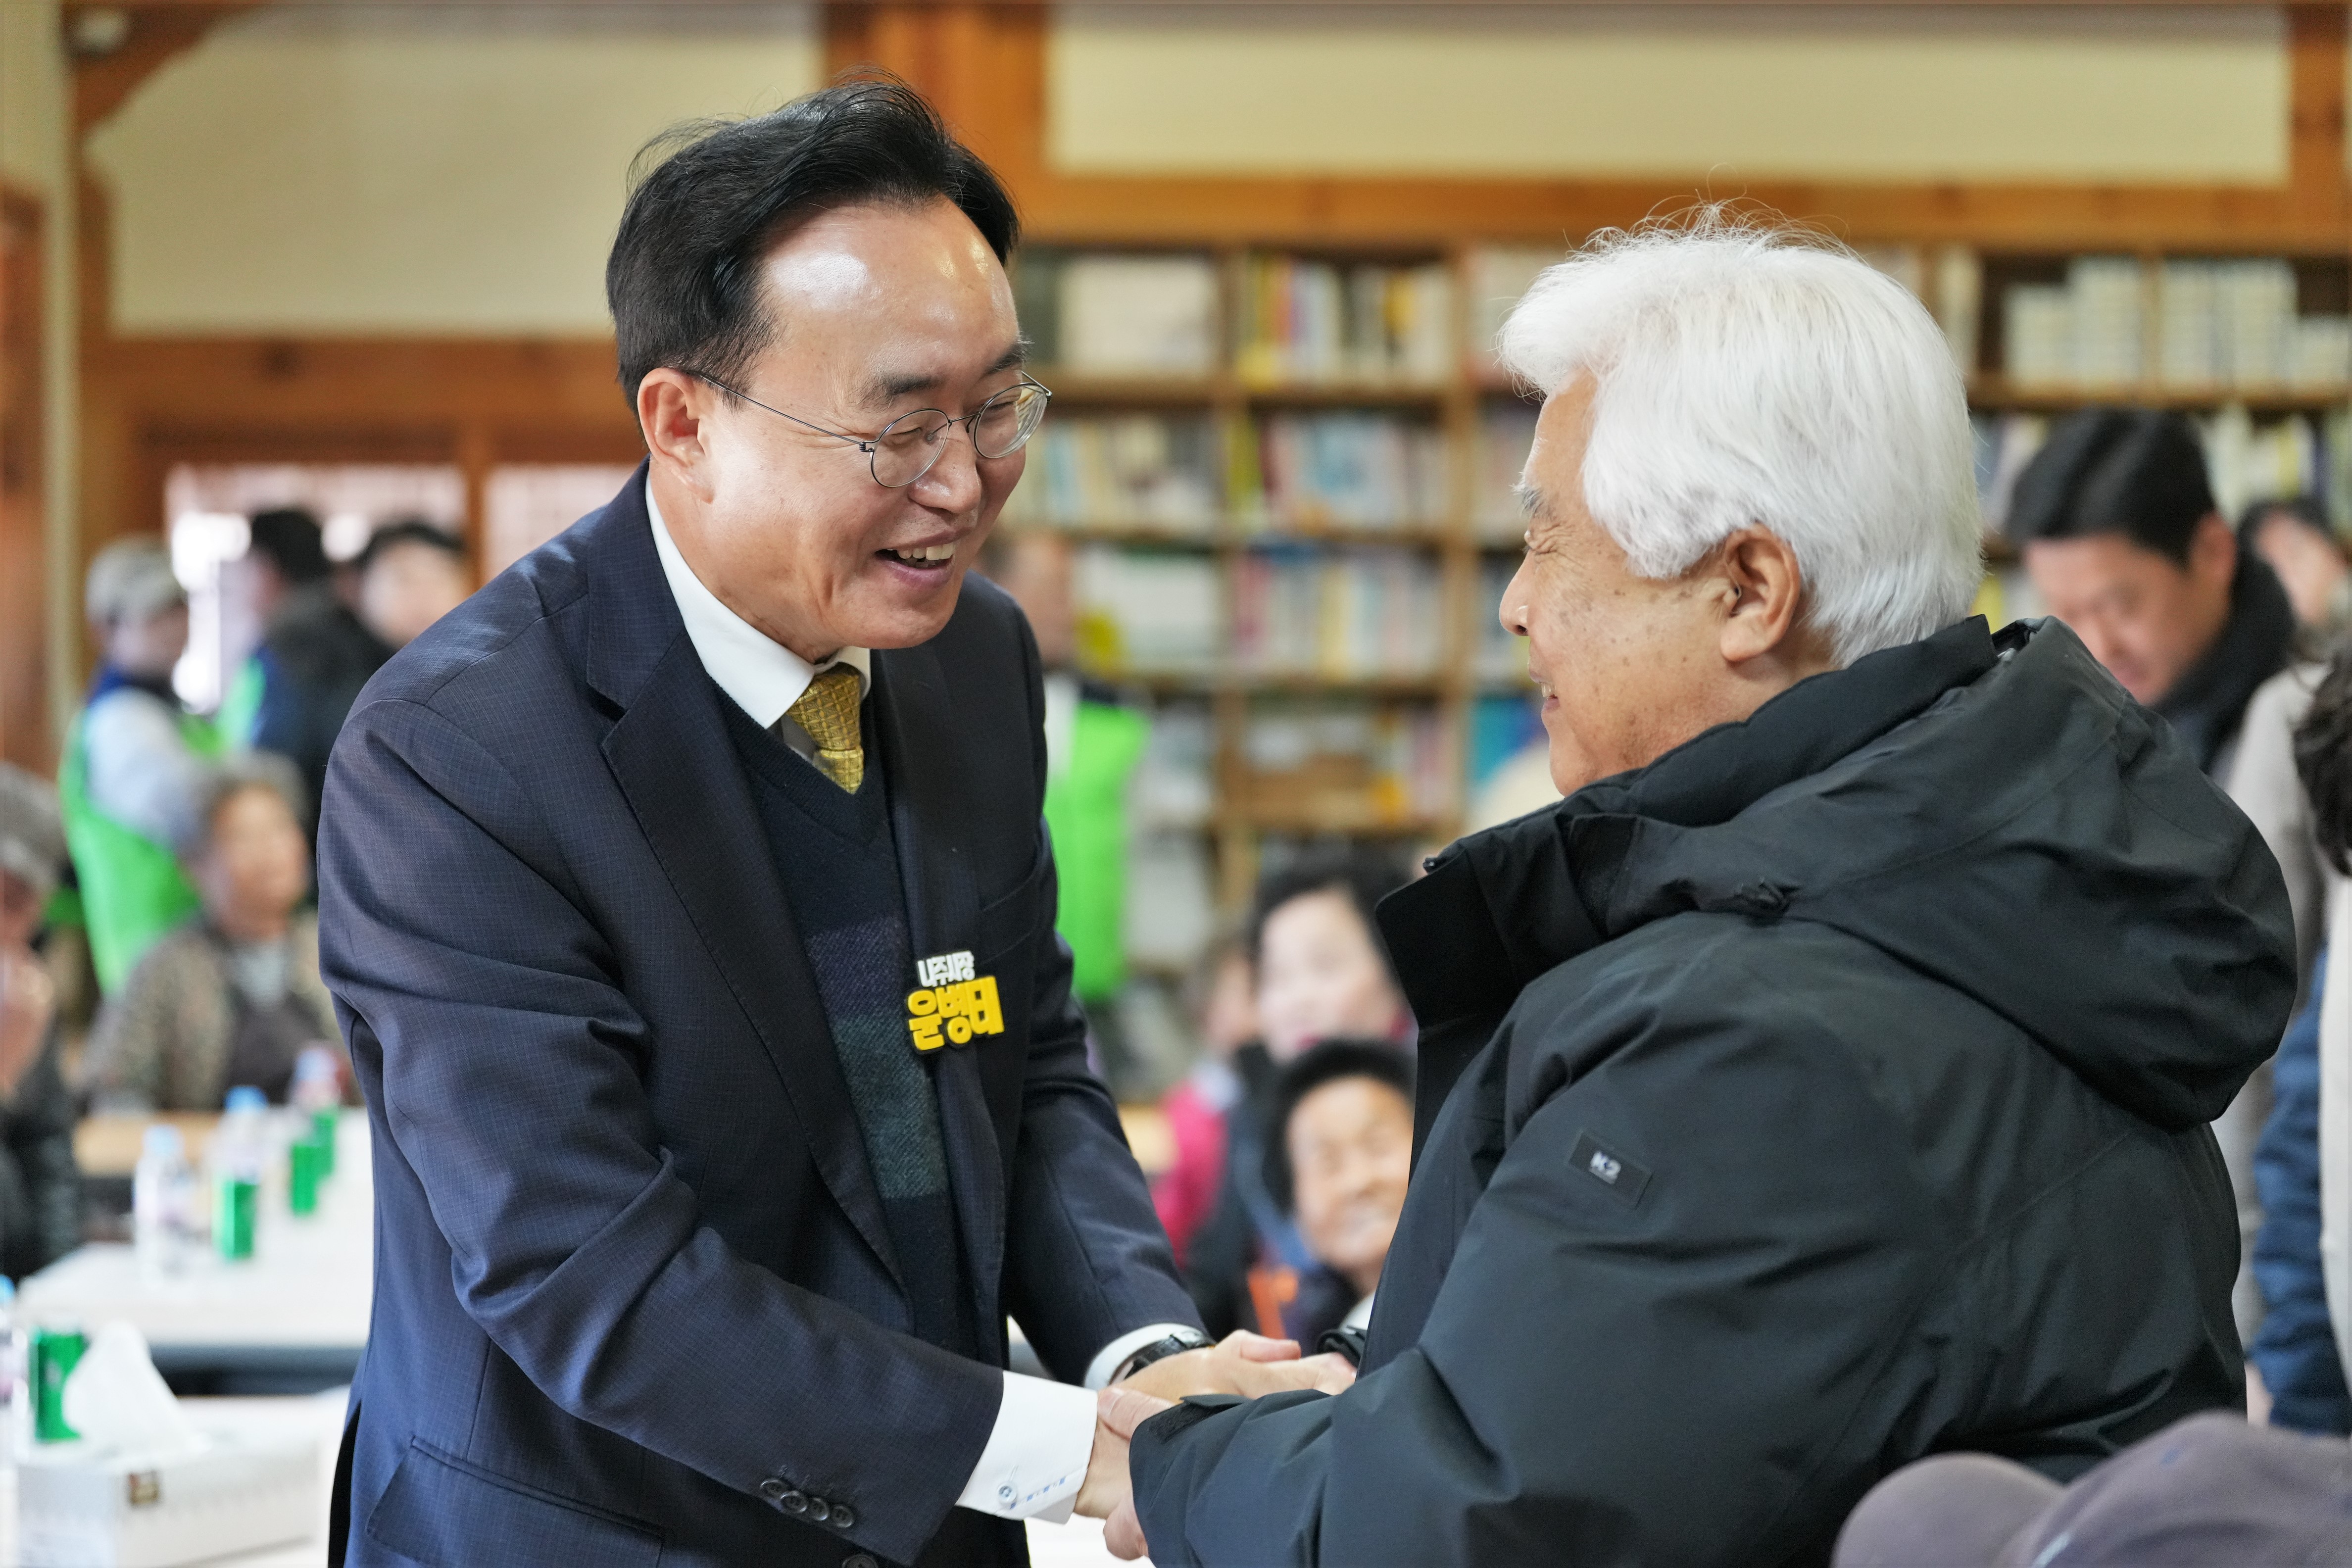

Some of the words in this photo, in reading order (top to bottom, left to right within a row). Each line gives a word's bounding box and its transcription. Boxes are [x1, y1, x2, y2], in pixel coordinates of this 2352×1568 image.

[917, 950, 975, 987] 나주시장
[907, 975, 1005, 1051] 윤병태
[1590, 1151, 1621, 1180] K2
